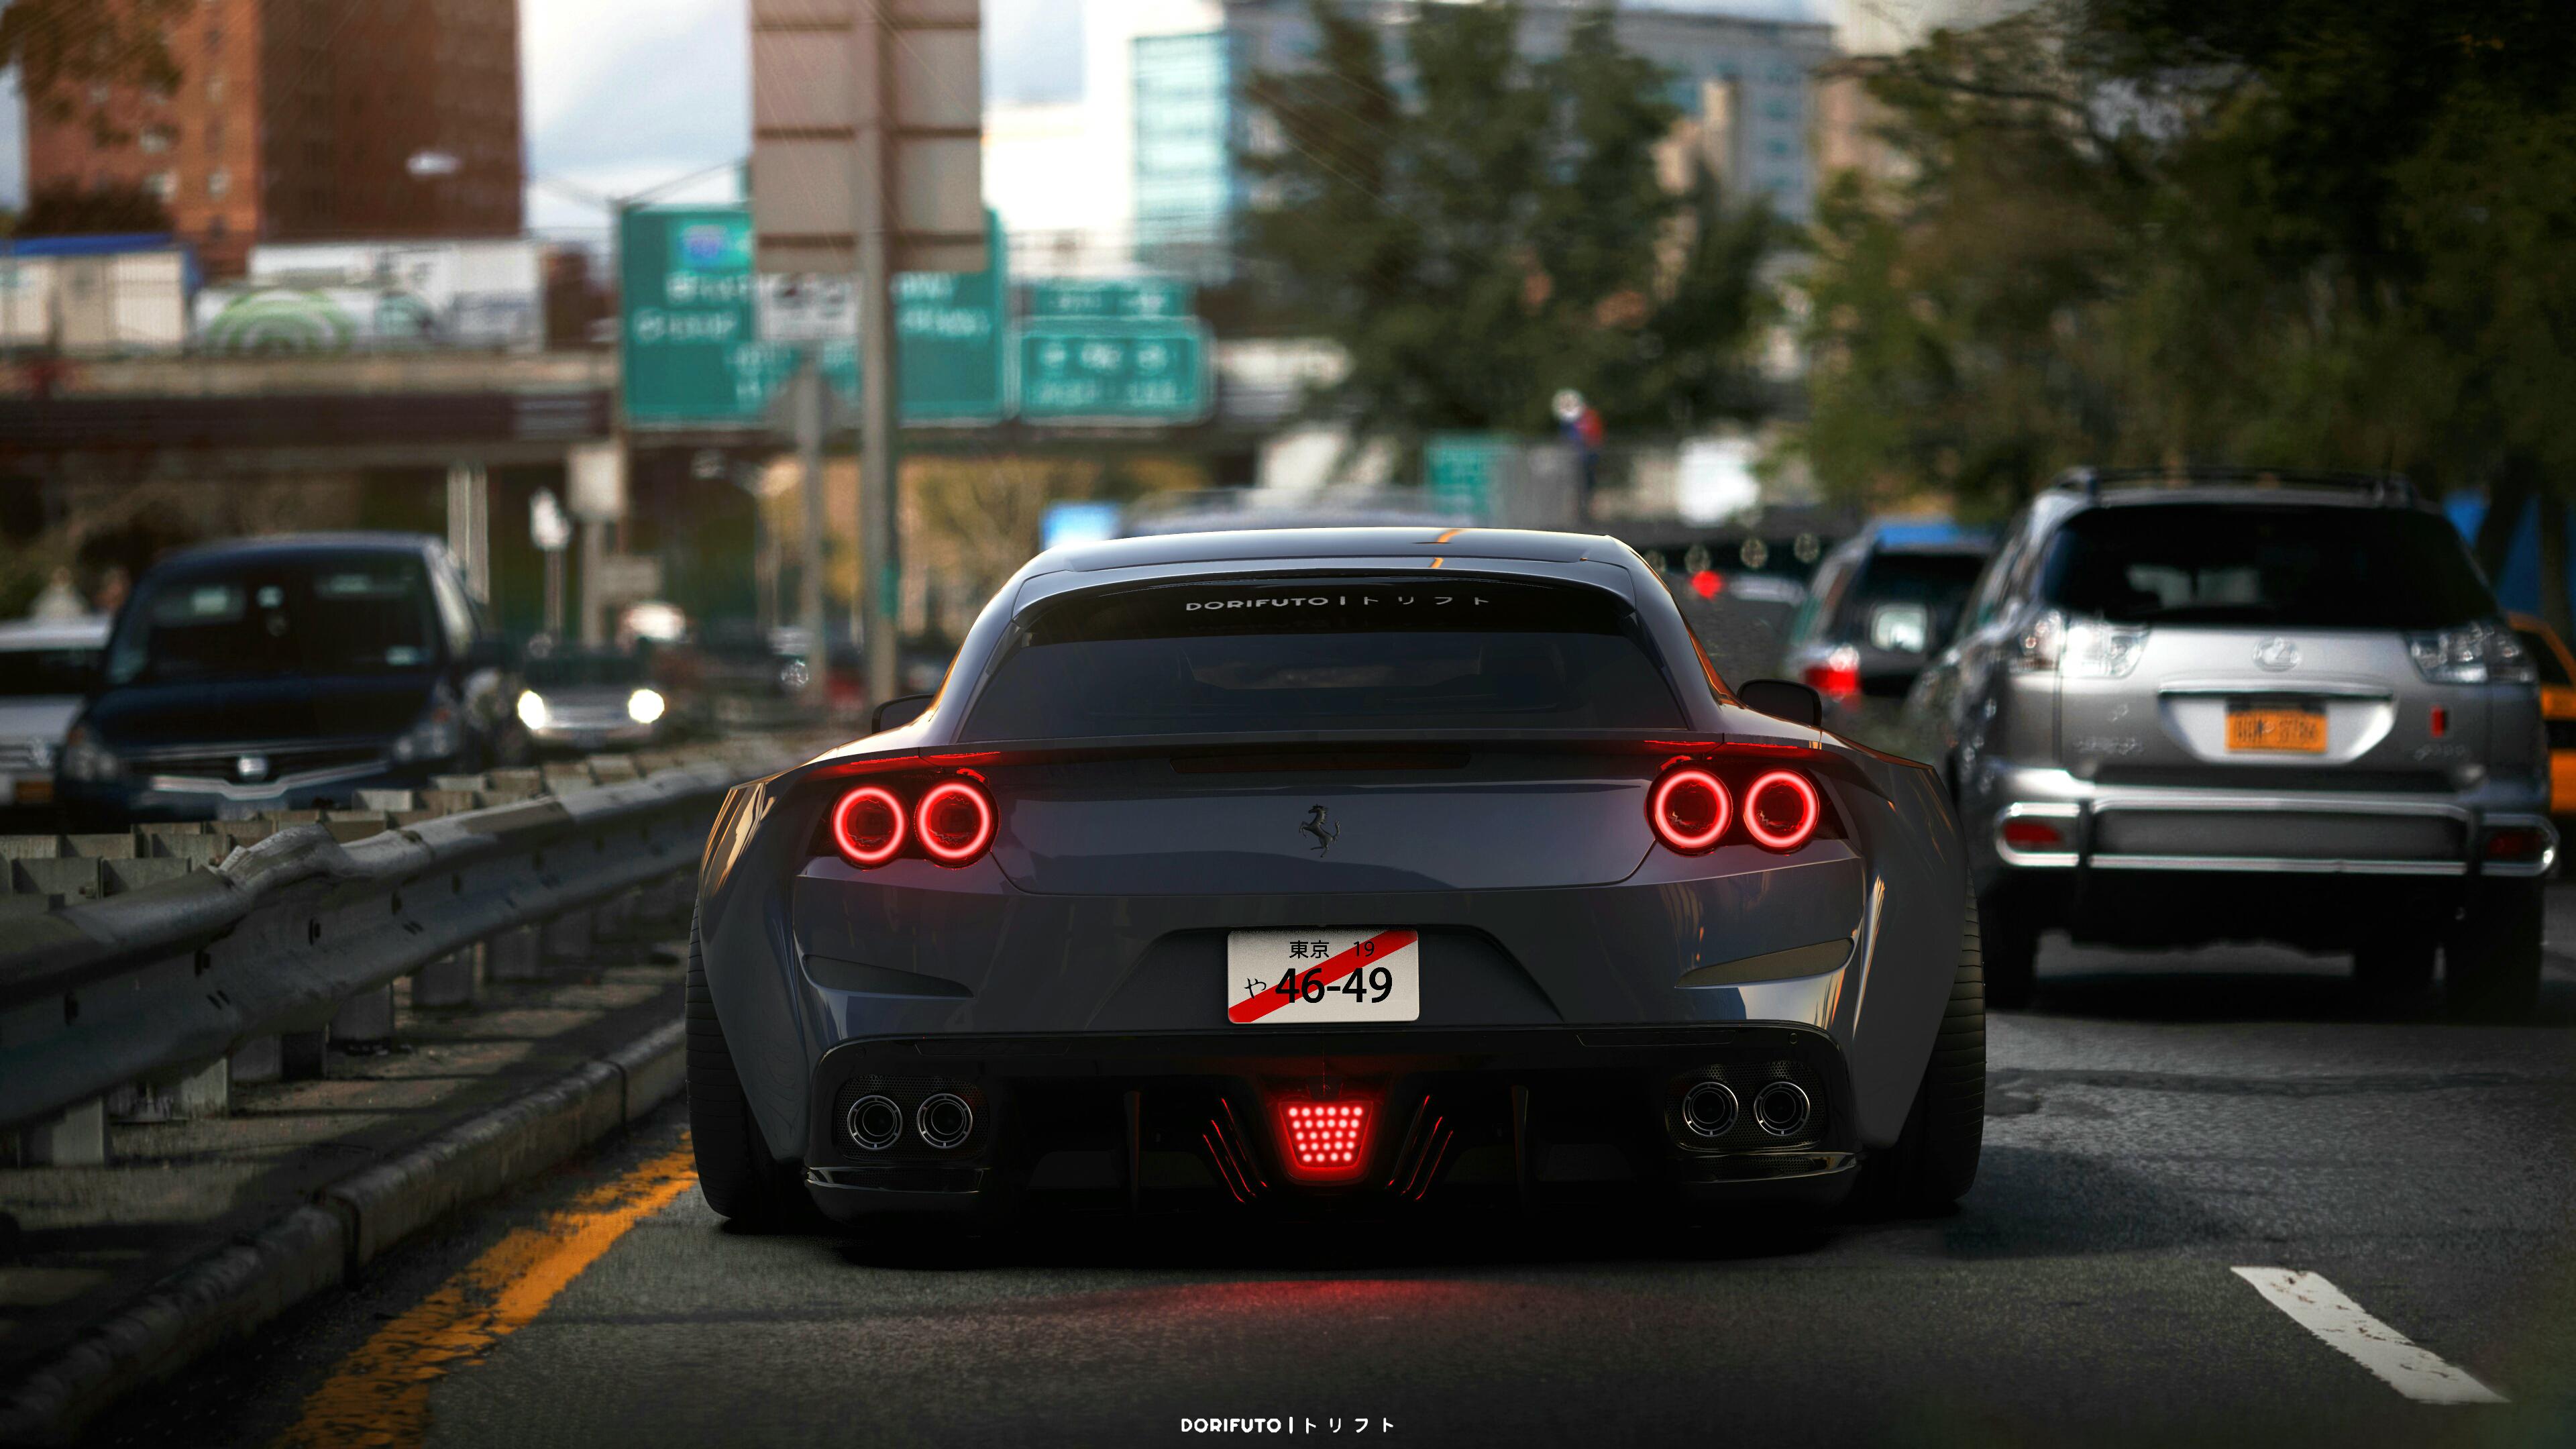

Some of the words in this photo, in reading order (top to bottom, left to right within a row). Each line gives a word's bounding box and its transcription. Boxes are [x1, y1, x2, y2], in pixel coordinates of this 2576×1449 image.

[1185, 596, 1328, 611] DORIFUTO
[1289, 940, 1330, 959] 東京
[1353, 941, 1375, 957] 19
[1244, 978, 1267, 1000] や
[1275, 967, 1393, 1004] 46-49
